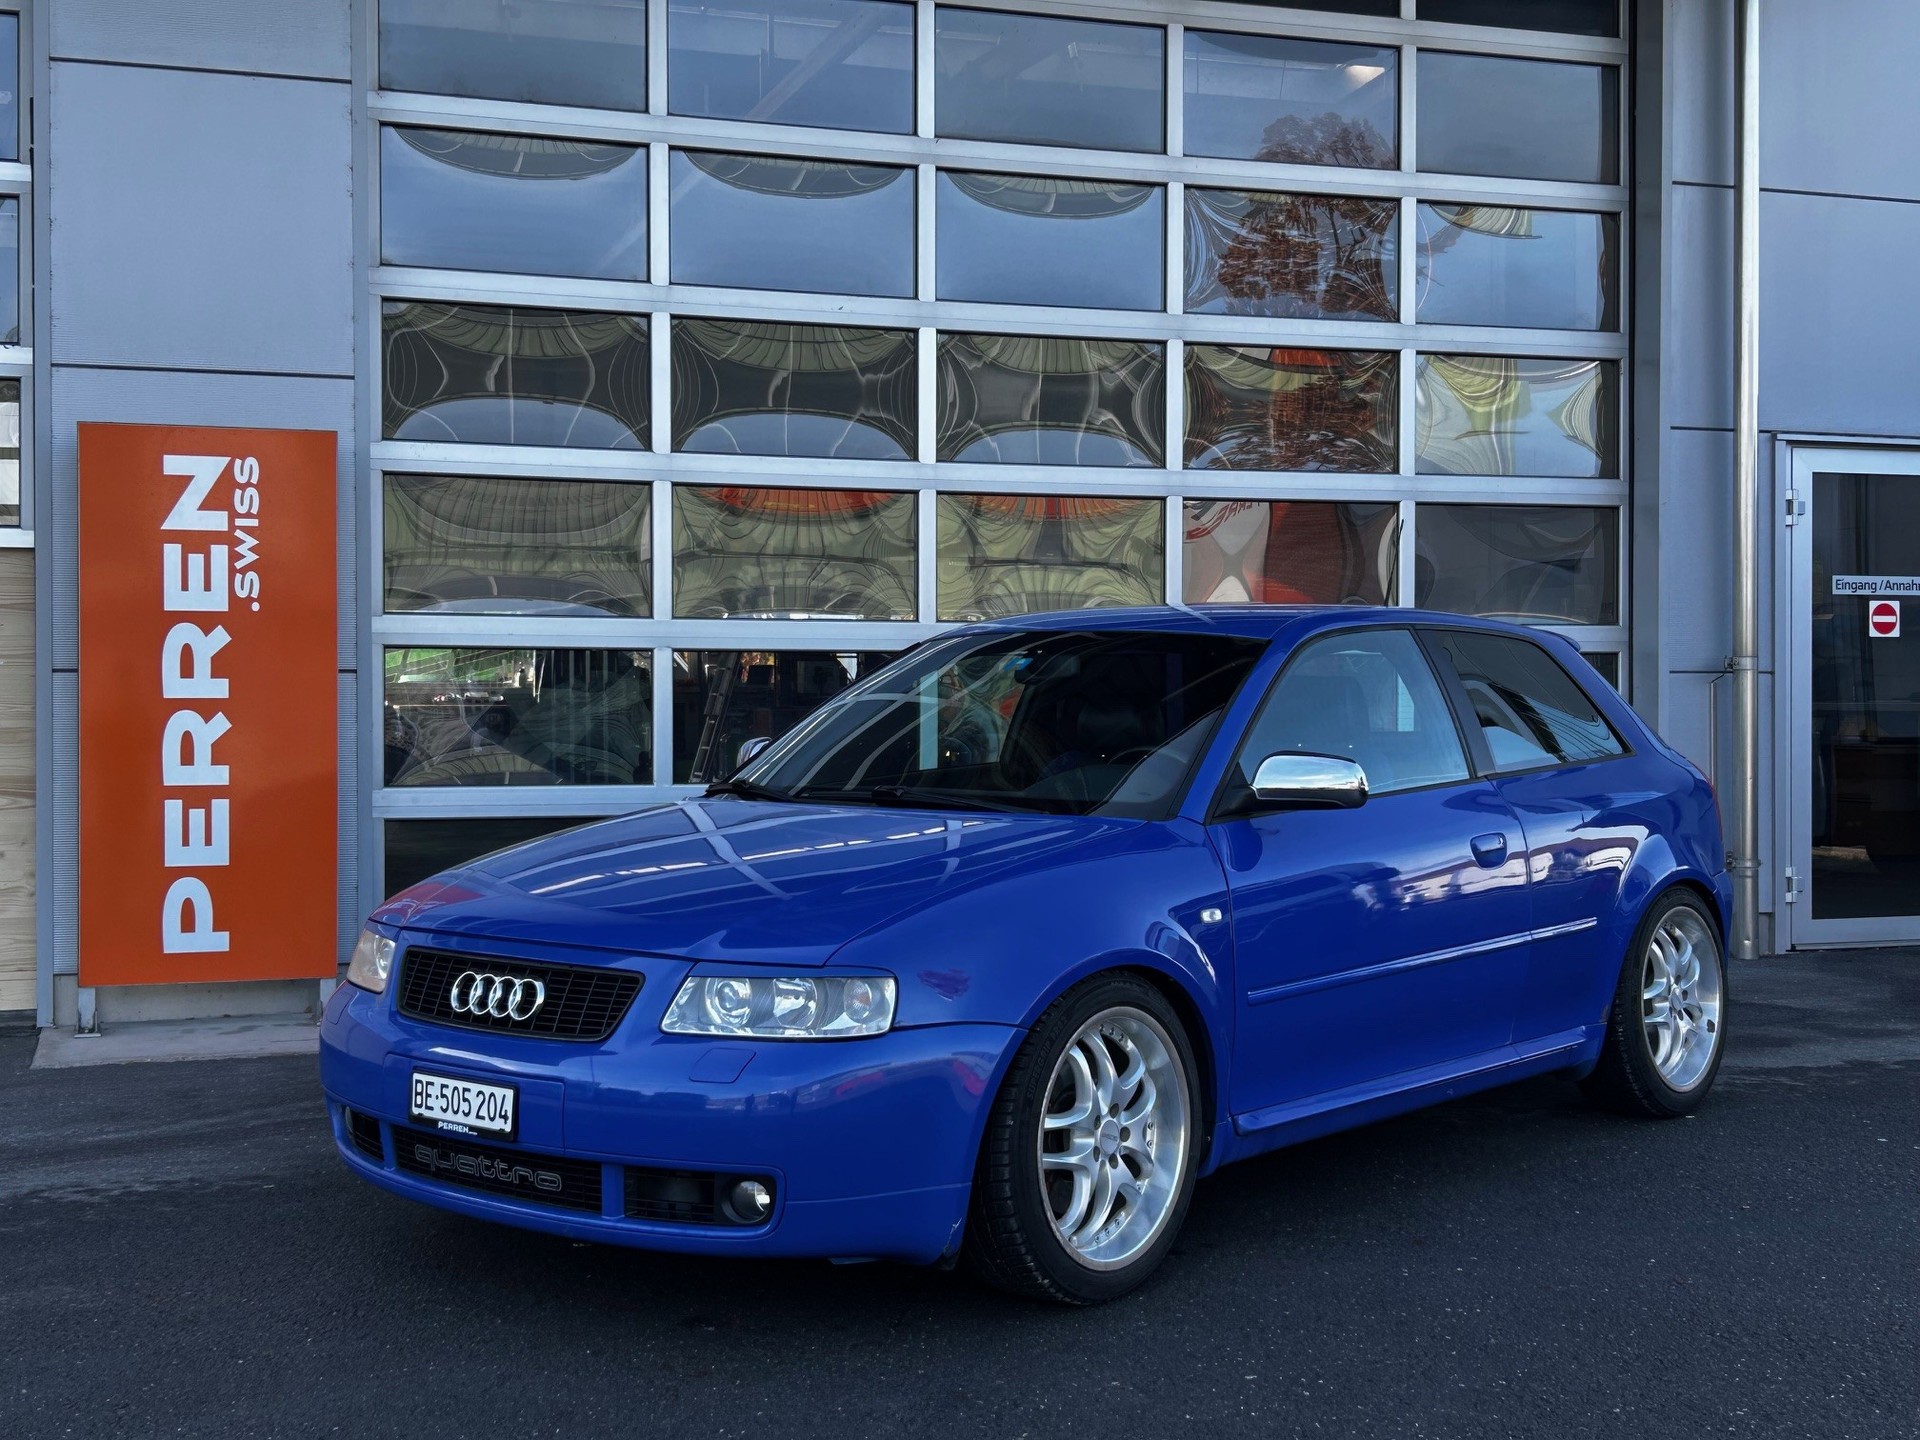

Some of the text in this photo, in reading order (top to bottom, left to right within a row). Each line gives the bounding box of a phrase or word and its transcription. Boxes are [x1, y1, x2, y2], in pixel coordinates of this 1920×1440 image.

[234, 456, 260, 611] .SWISS
[1835, 578, 1877, 593] Eingang
[161, 454, 232, 953] PERREN
[438, 1120, 469, 1134] PERREN
[414, 1144, 562, 1192] quattro
